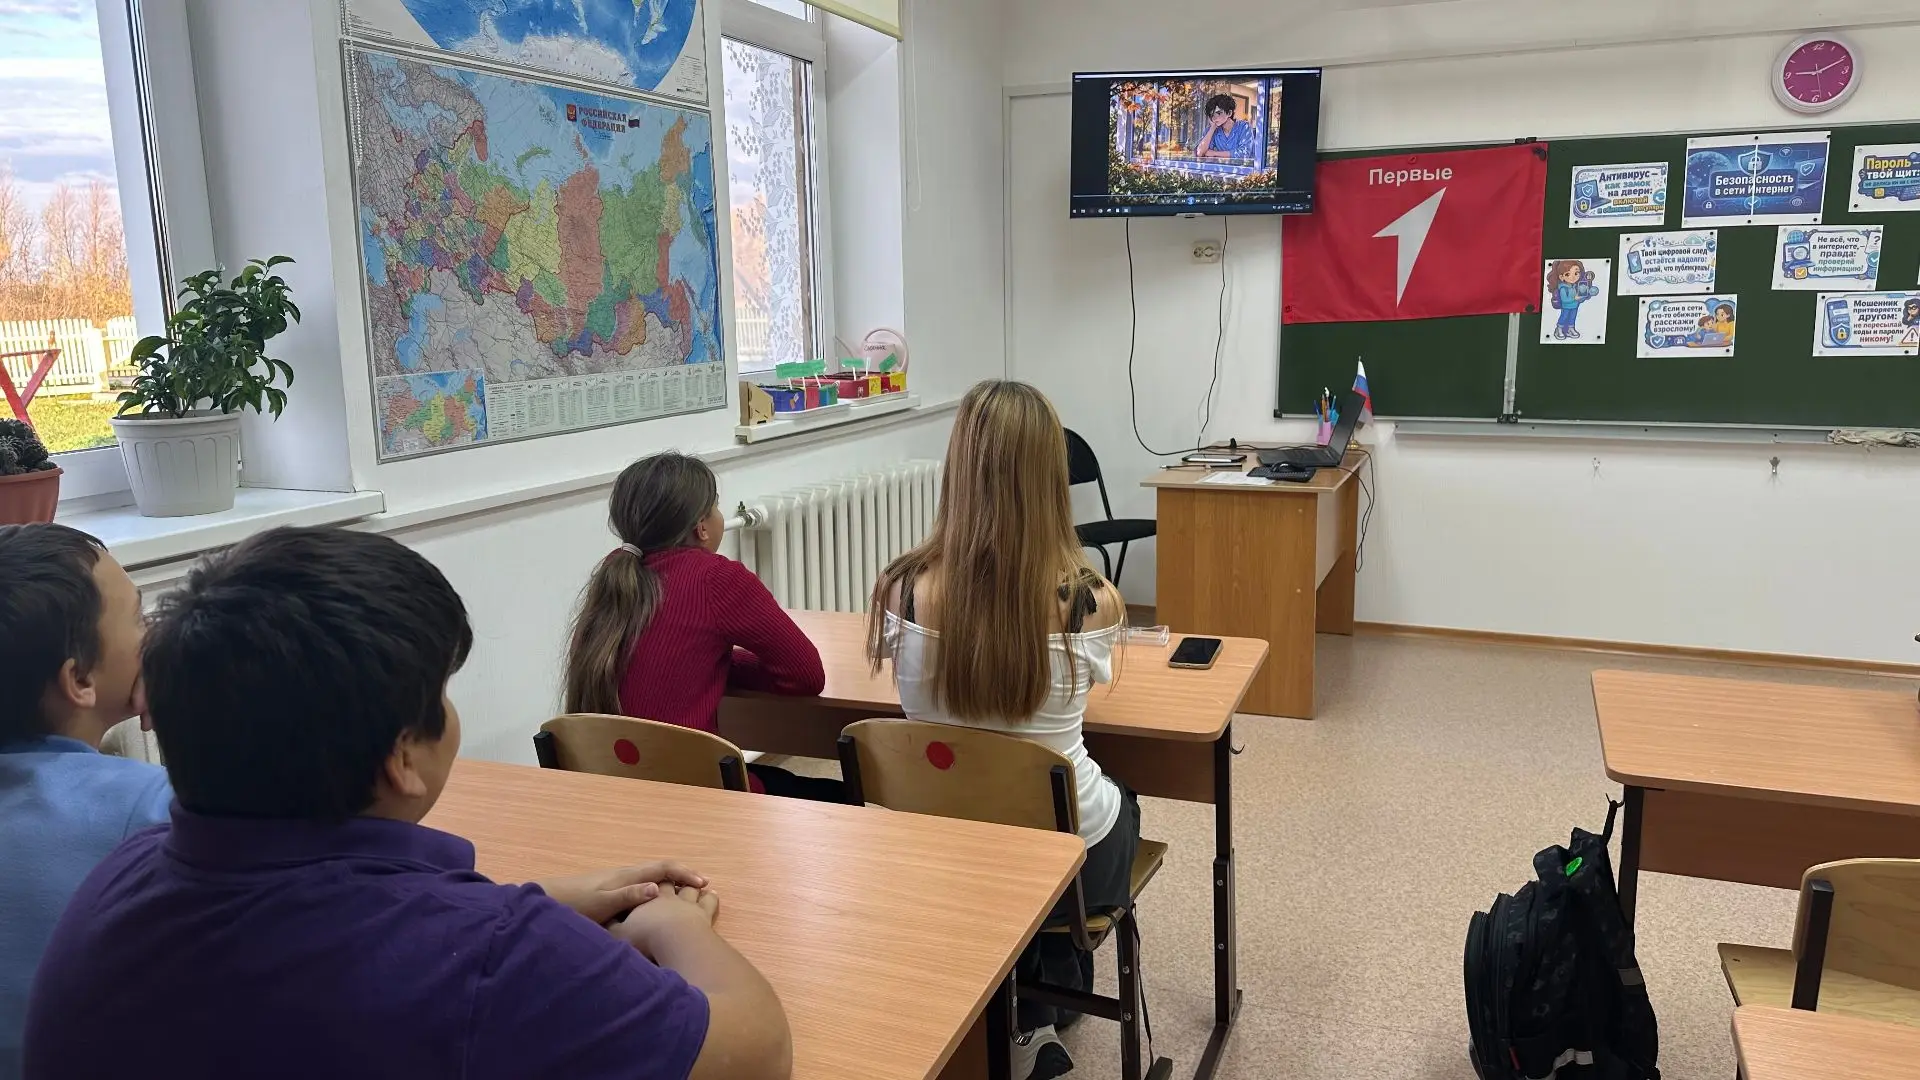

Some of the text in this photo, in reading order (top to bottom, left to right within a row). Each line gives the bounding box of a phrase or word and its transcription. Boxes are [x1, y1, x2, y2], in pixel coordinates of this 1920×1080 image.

[1813, 43, 1825, 51] 12
[1841, 66, 1850, 75] 3
[1784, 72, 1792, 80] 9
[1811, 94, 1820, 102] 6
[1867, 158, 1911, 171] Пароль
[1369, 167, 1453, 186] Первые
[1599, 171, 1650, 182] Антивирус
[1867, 169, 1920, 179] твой щит:
[1623, 180, 1651, 188] замок
[1715, 174, 1794, 186] Безопасность
[1621, 188, 1652, 197] двери:
[1723, 187, 1745, 195] сети
[1747, 185, 1794, 195] Интернет
[1613, 196, 1648, 206] включай
[1641, 249, 1657, 257] Твой
[1658, 248, 1691, 256] цифровой
[1645, 257, 1675, 265] остаётся
[1643, 266, 1663, 275] думай,
[1813, 264, 1864, 273] информацию!
[1858, 313, 1898, 322] другом:
[1653, 325, 1696, 333] взрослому!
[1863, 321, 1902, 329] пересылай
[1859, 335, 1894, 344] никому!
